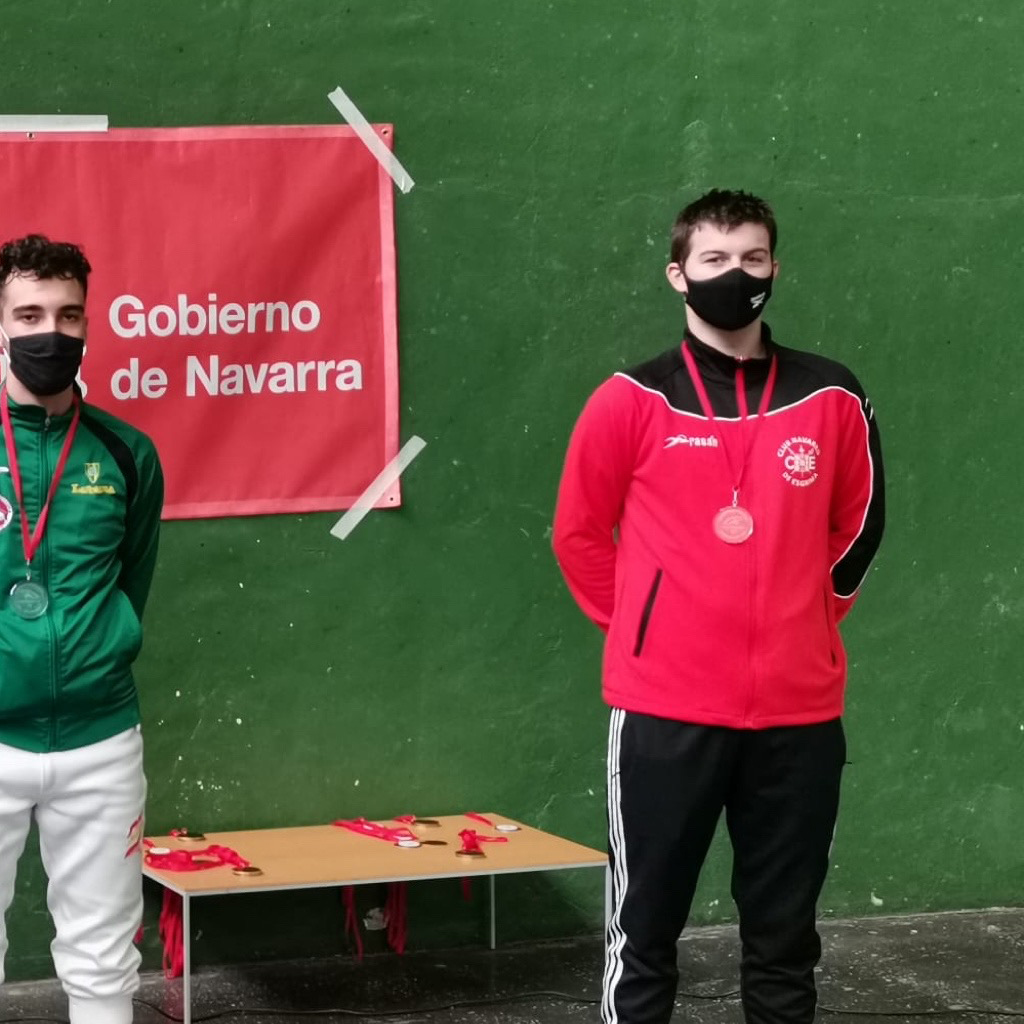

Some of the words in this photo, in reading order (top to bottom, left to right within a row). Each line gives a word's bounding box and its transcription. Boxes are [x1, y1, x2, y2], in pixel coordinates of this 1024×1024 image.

[108, 293, 321, 339] Gobierno
[110, 357, 168, 400] de
[186, 354, 363, 397] Navarra
